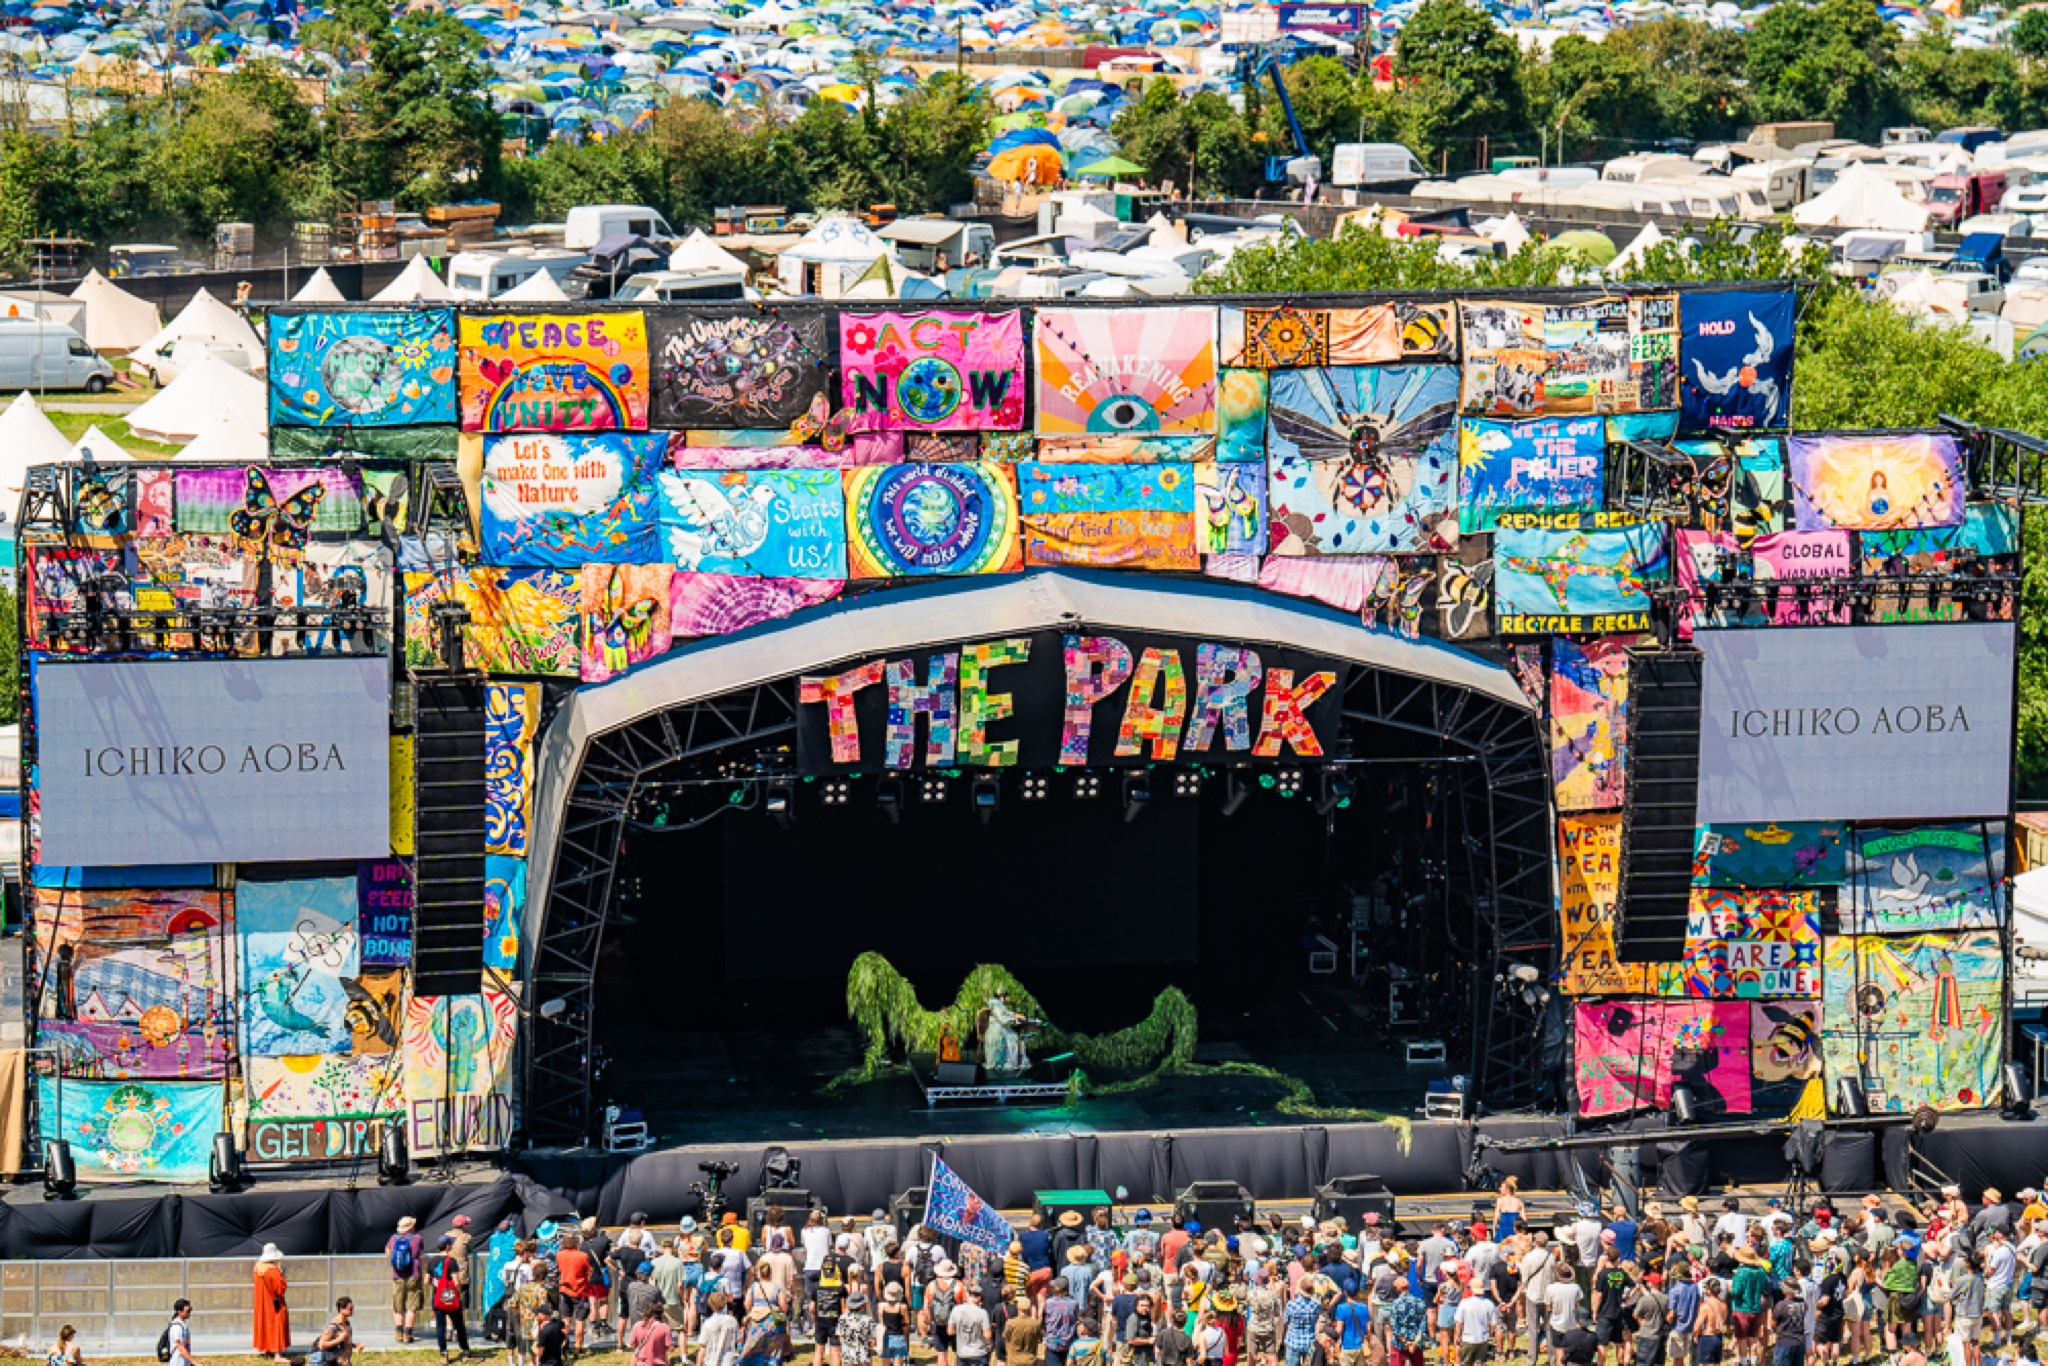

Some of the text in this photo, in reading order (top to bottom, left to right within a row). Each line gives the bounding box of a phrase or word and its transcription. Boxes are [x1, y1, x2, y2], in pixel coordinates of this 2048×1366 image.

[287, 315, 350, 339] STAY
[500, 319, 608, 350] PEACE
[875, 317, 979, 350] ACT
[1700, 319, 1736, 336] HOLD
[329, 353, 389, 373] MOON
[511, 364, 590, 392] LOVE
[1060, 354, 1191, 405] REAWAKENING
[854, 369, 1015, 414] NOW
[499, 398, 598, 428] UNITY
[1567, 421, 1598, 437] GOT
[513, 440, 552, 460] Let's
[1532, 438, 1577, 456] THE
[497, 461, 607, 481] make One with
[900, 463, 930, 484] world
[517, 483, 579, 503] Nature
[773, 497, 840, 524] Starts
[1500, 512, 1580, 529] REDUCE
[788, 519, 828, 538] with
[1117, 518, 1134, 535] to
[788, 540, 832, 569] us!
[921, 546, 957, 564] make
[1781, 544, 1845, 559] GLOBAL
[1501, 616, 1582, 633] RECYCLE
[799, 634, 1337, 769] THE PARK
[1730, 704, 1971, 738] ICHIKO AOBA
[83, 742, 347, 777] ICHIKO AOBA
[373, 915, 410, 933] NOT
[1688, 914, 1721, 936] WE
[1732, 943, 1782, 967] ARE
[1765, 970, 1807, 992] ONE
[255, 1122, 313, 1159] GET
[930, 1211, 997, 1247] MONSTER
